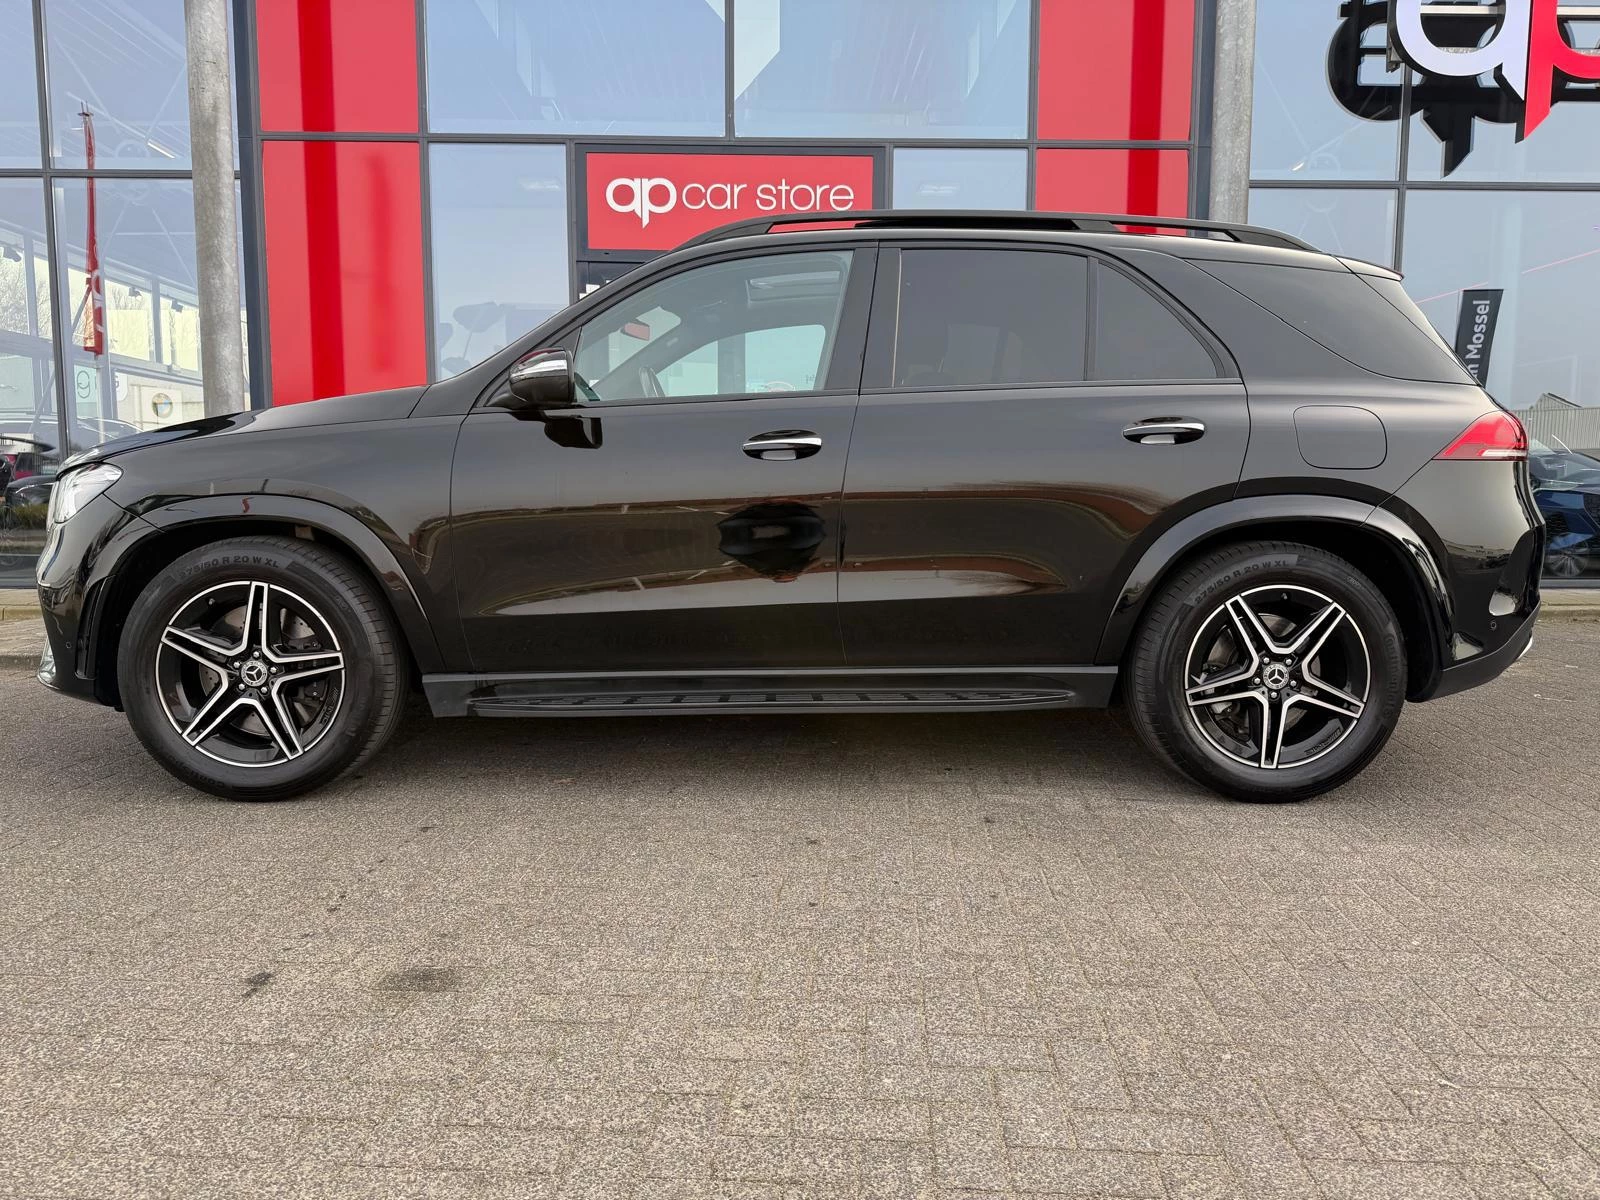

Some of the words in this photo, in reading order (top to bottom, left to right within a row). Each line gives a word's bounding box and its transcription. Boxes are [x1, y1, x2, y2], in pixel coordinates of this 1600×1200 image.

[605, 177, 677, 229] ap
[682, 183, 747, 210] car
[755, 178, 855, 211] store
[1465, 299, 1490, 359] Mossel
[222, 556, 230, 564] R
[233, 555, 249, 563] 20
[252, 556, 262, 564] W
[264, 557, 279, 568] XL
[1232, 569, 1242, 578] R
[1244, 563, 1259, 574] 20
[1262, 560, 1271, 569] W
[1274, 559, 1289, 568] XL
